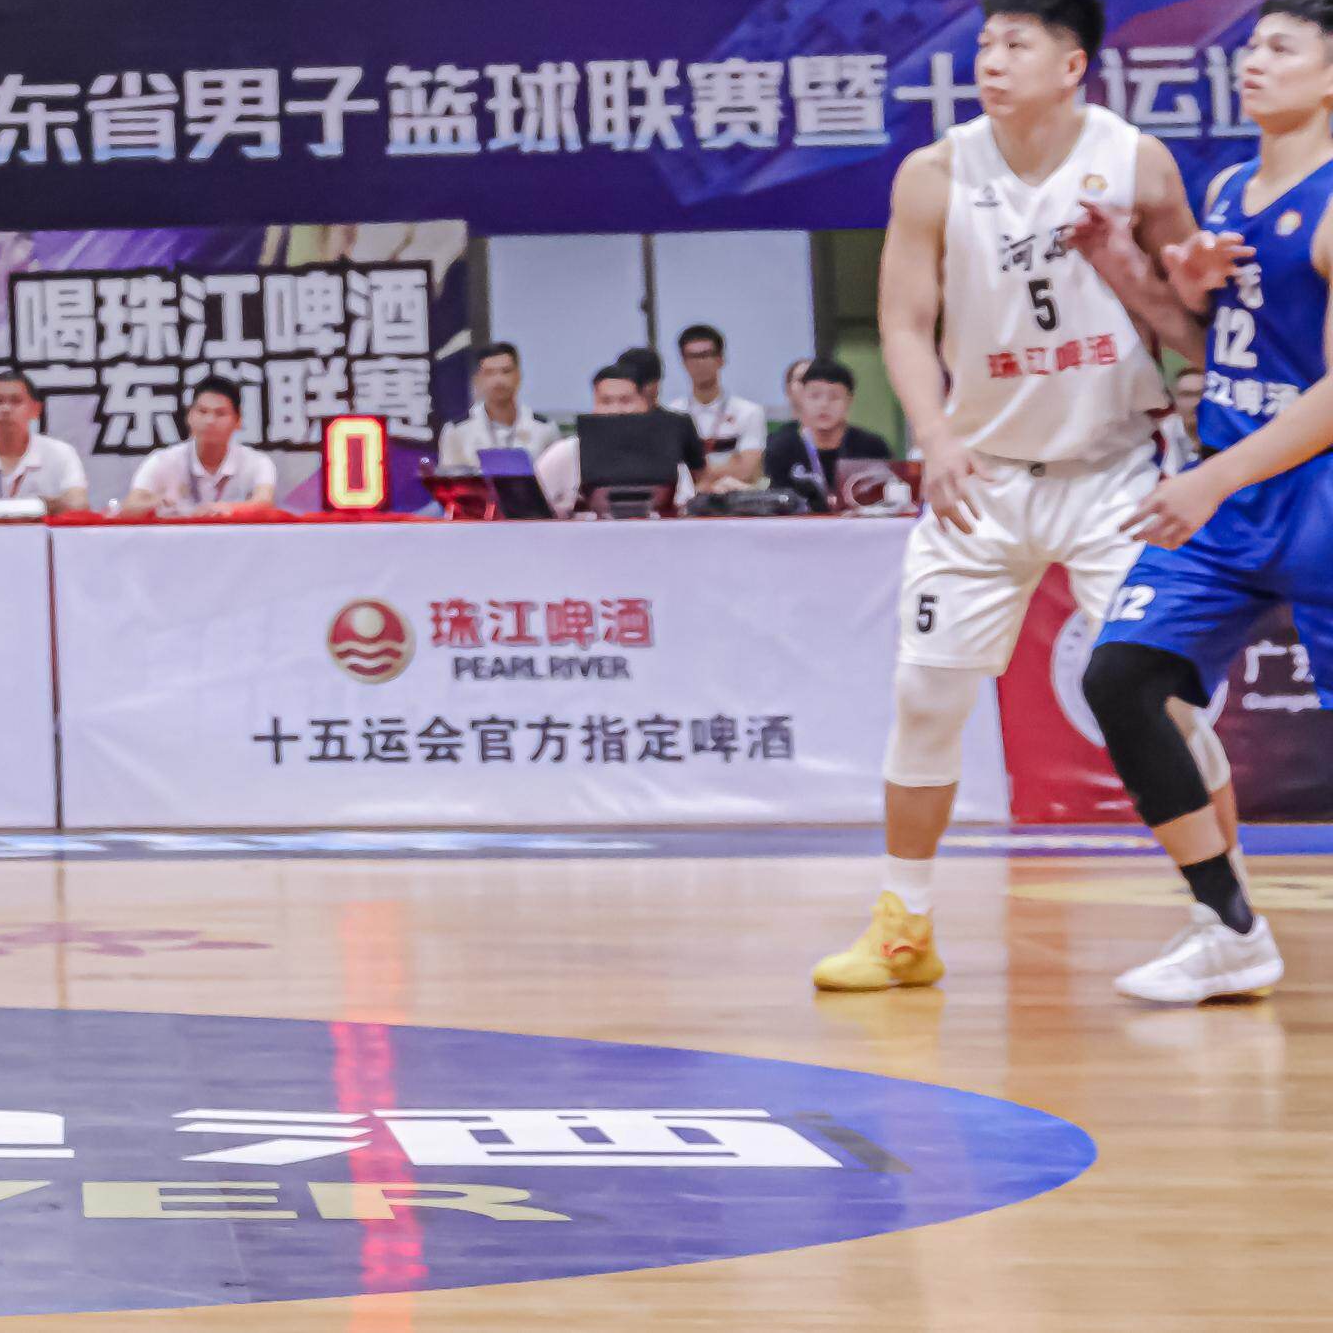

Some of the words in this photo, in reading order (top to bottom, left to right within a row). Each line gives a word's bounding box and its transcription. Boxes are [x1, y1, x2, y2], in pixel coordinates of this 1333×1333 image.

[14, 268, 430, 362] 喝珠江啤酒
[1028, 277, 1059, 331] 5
[1213, 306, 1259, 369] 12
[326, 416, 385, 510] 0
[428, 597, 654, 650] 珠江啤酒
[916, 594, 939, 634] 5
[454, 656, 545, 680] PEARL
[548, 655, 630, 679] RIVER
[252, 713, 796, 765] 十五运会官方指定啤酒
